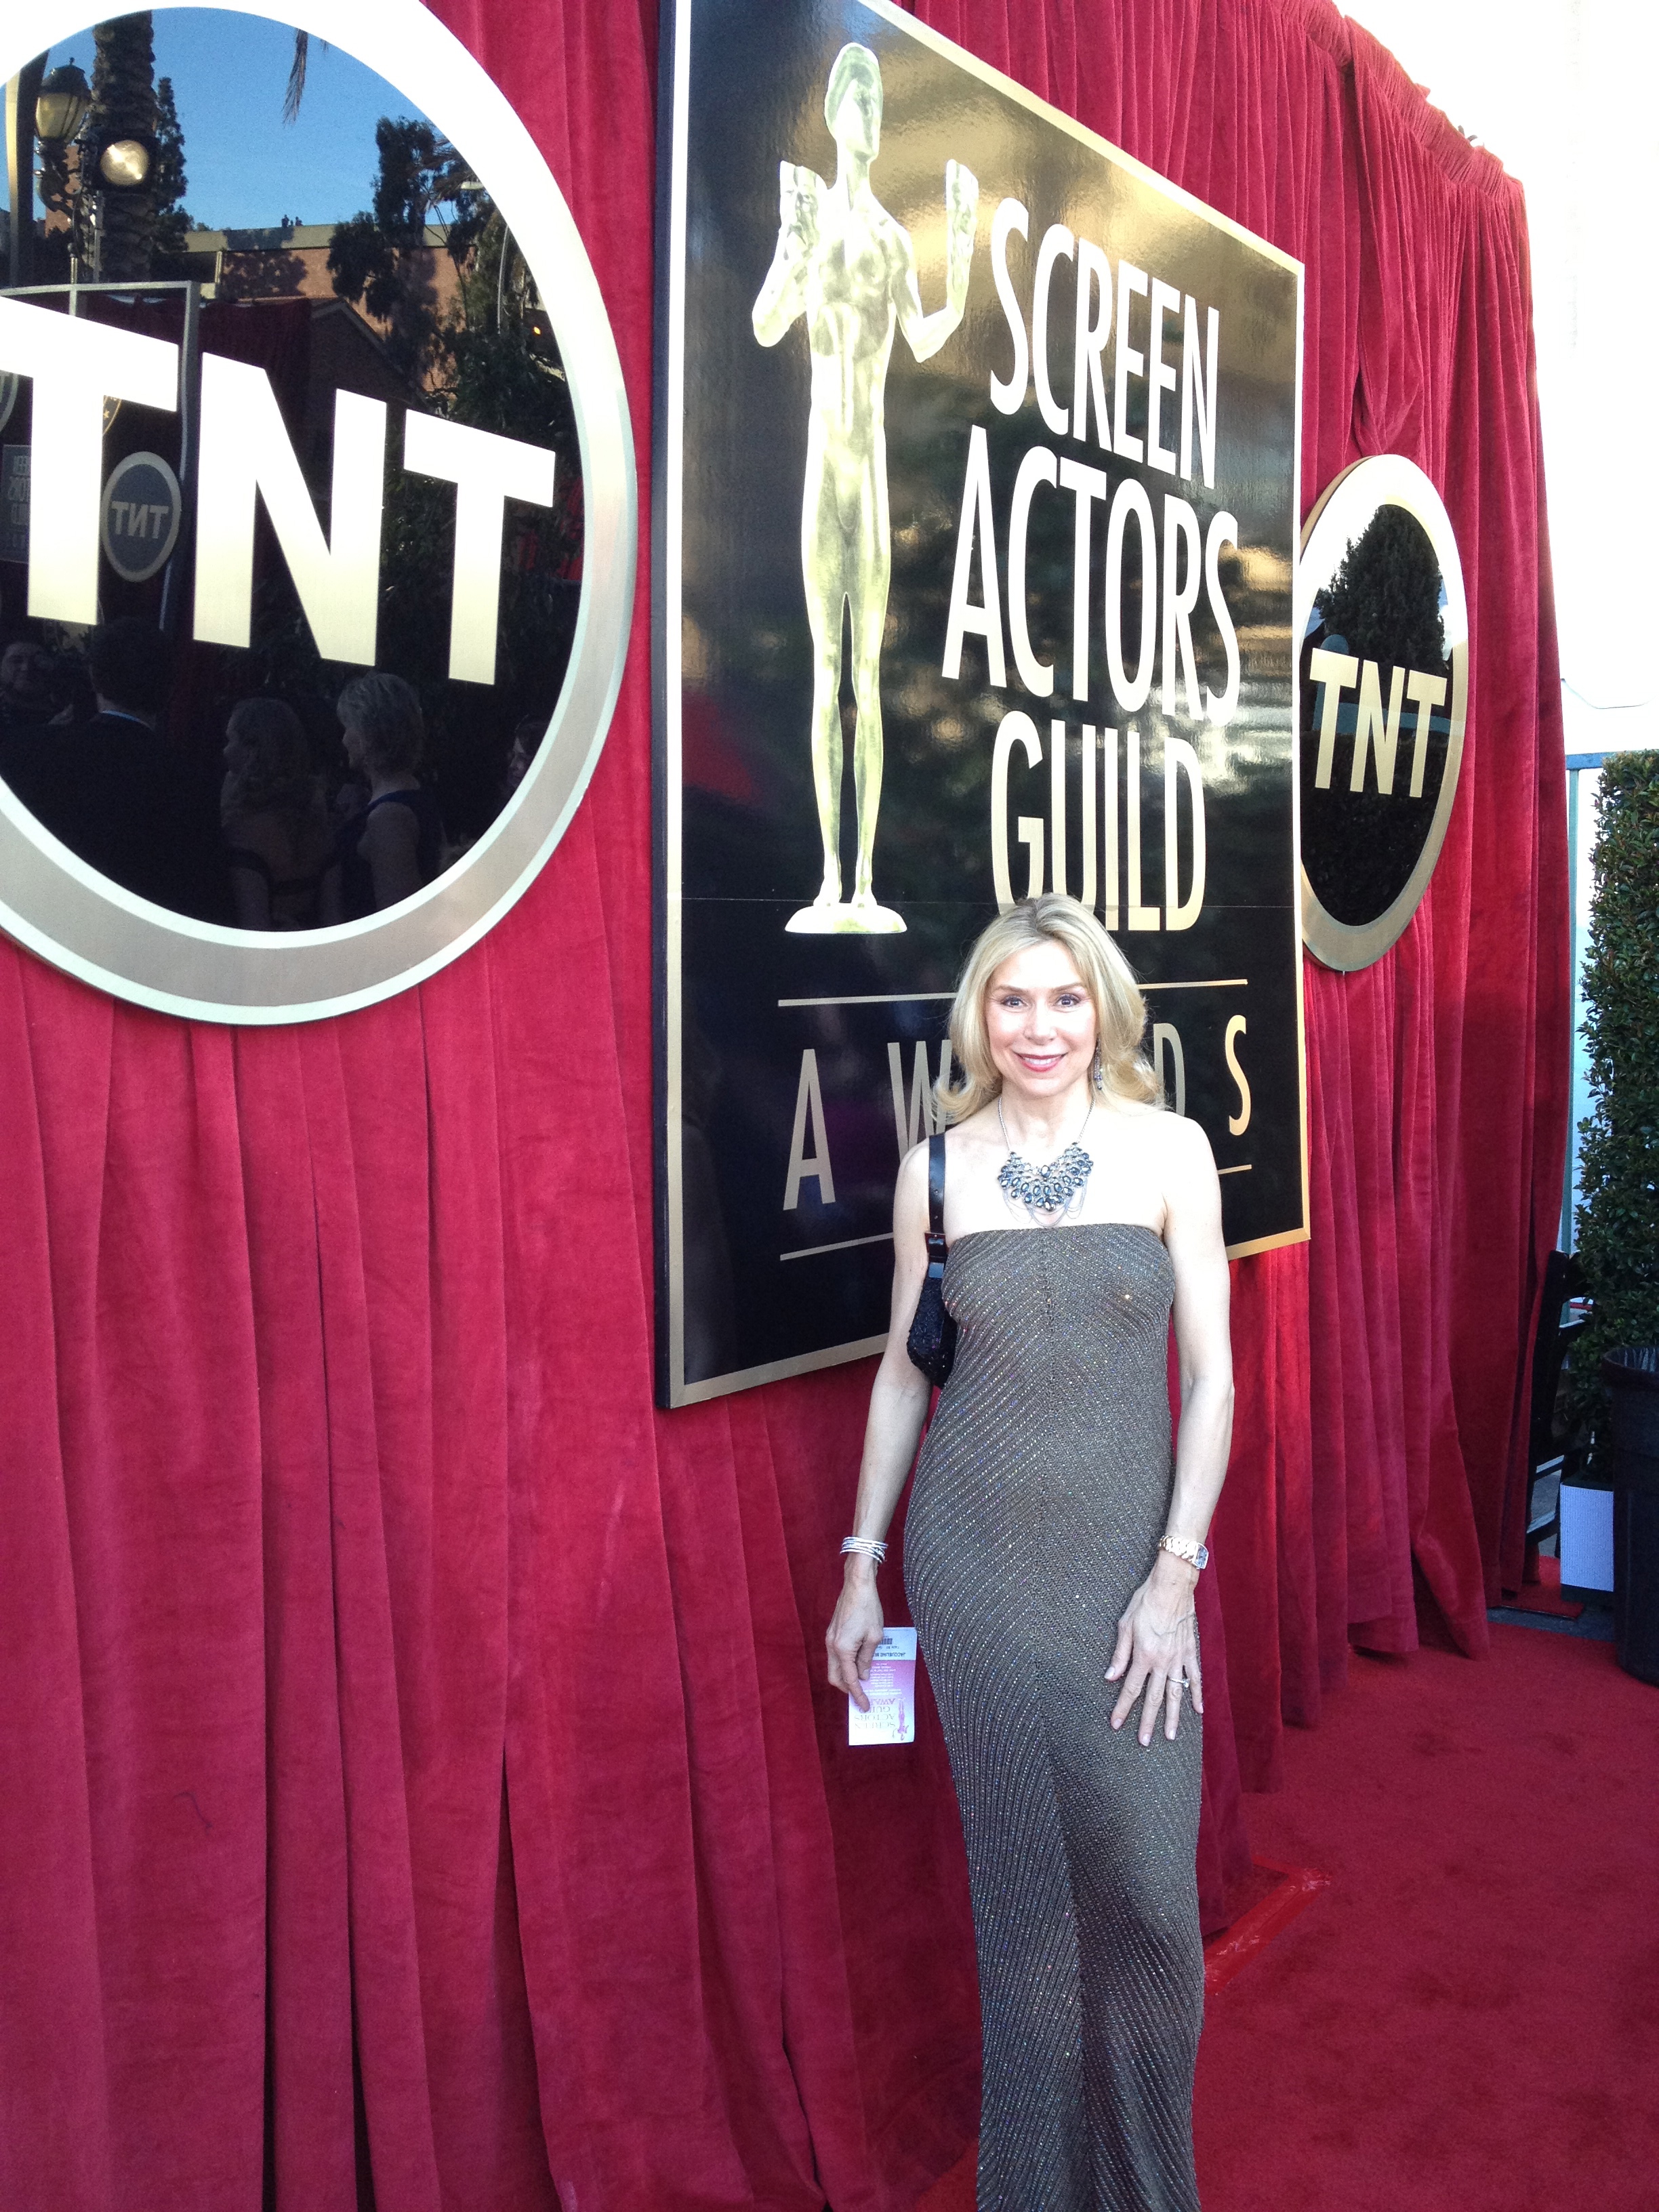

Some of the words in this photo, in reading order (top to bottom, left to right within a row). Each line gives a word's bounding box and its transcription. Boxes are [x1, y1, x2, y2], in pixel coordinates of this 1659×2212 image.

[990, 197, 1219, 489] SCREEN
[0, 296, 556, 685] TNT
[941, 424, 1240, 726] ACTORS
[991, 710, 1206, 931] GUILD
[1309, 648, 1448, 798] TNT
[782, 1015, 1252, 1210] AWDS
[854, 1713, 896, 1721] ACTORS
